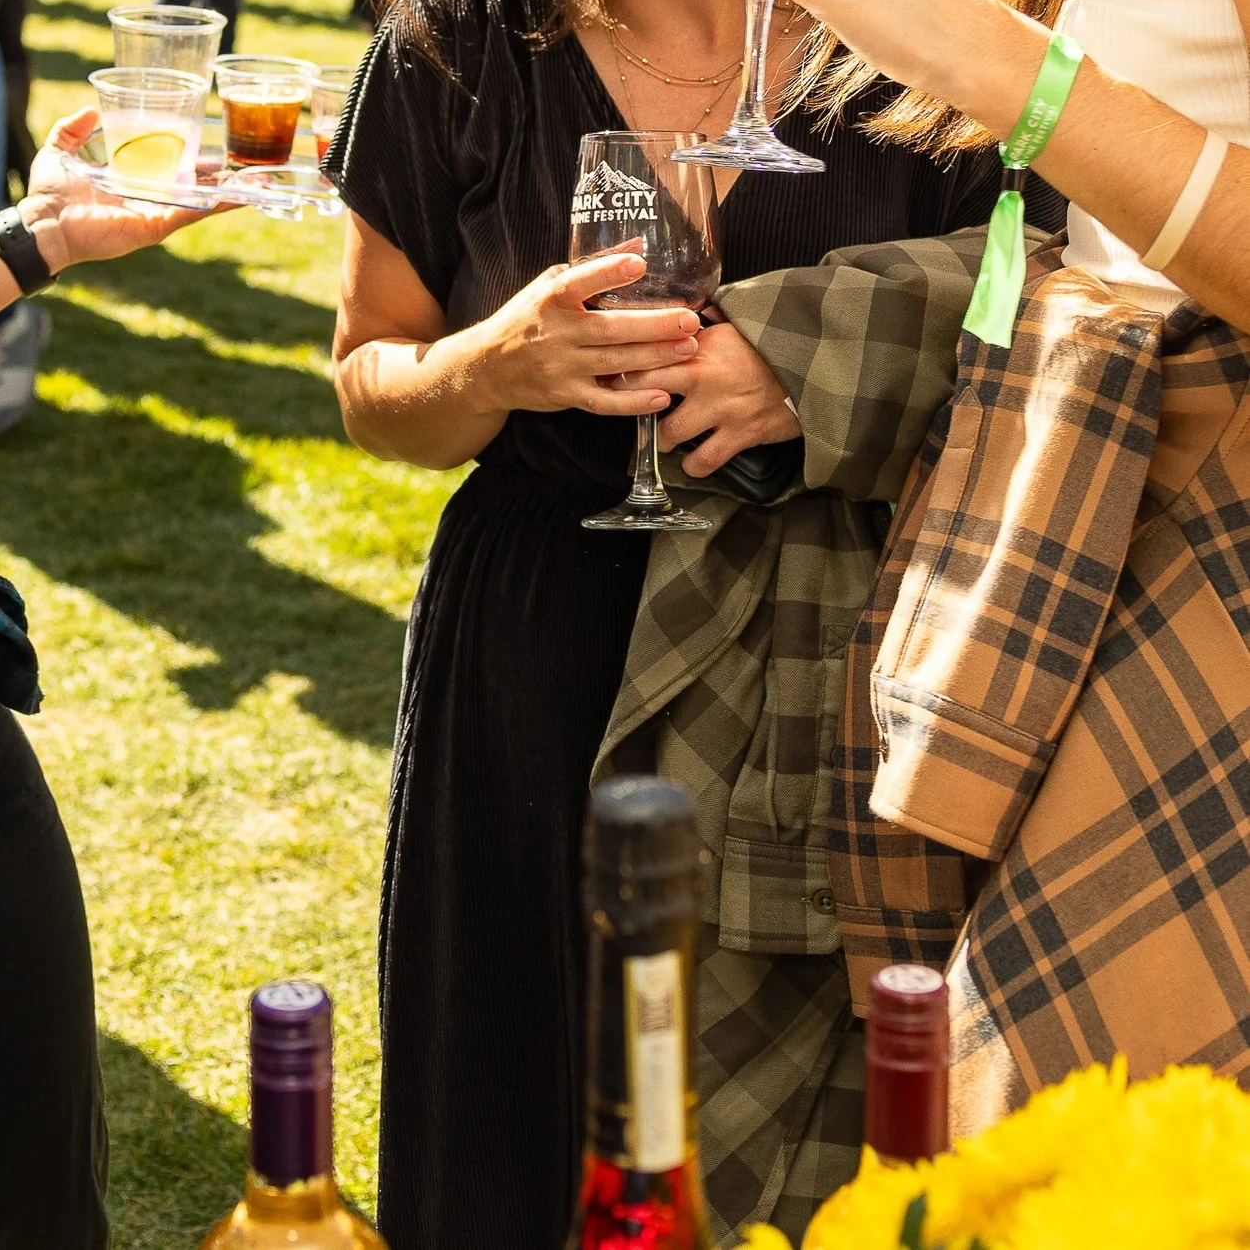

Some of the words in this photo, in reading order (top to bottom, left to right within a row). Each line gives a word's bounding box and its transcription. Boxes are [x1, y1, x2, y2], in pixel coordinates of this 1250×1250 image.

[1027, 97, 1048, 128] CITY
[611, 190, 658, 208] CITY
[593, 208, 658, 222] FESTIVAL
